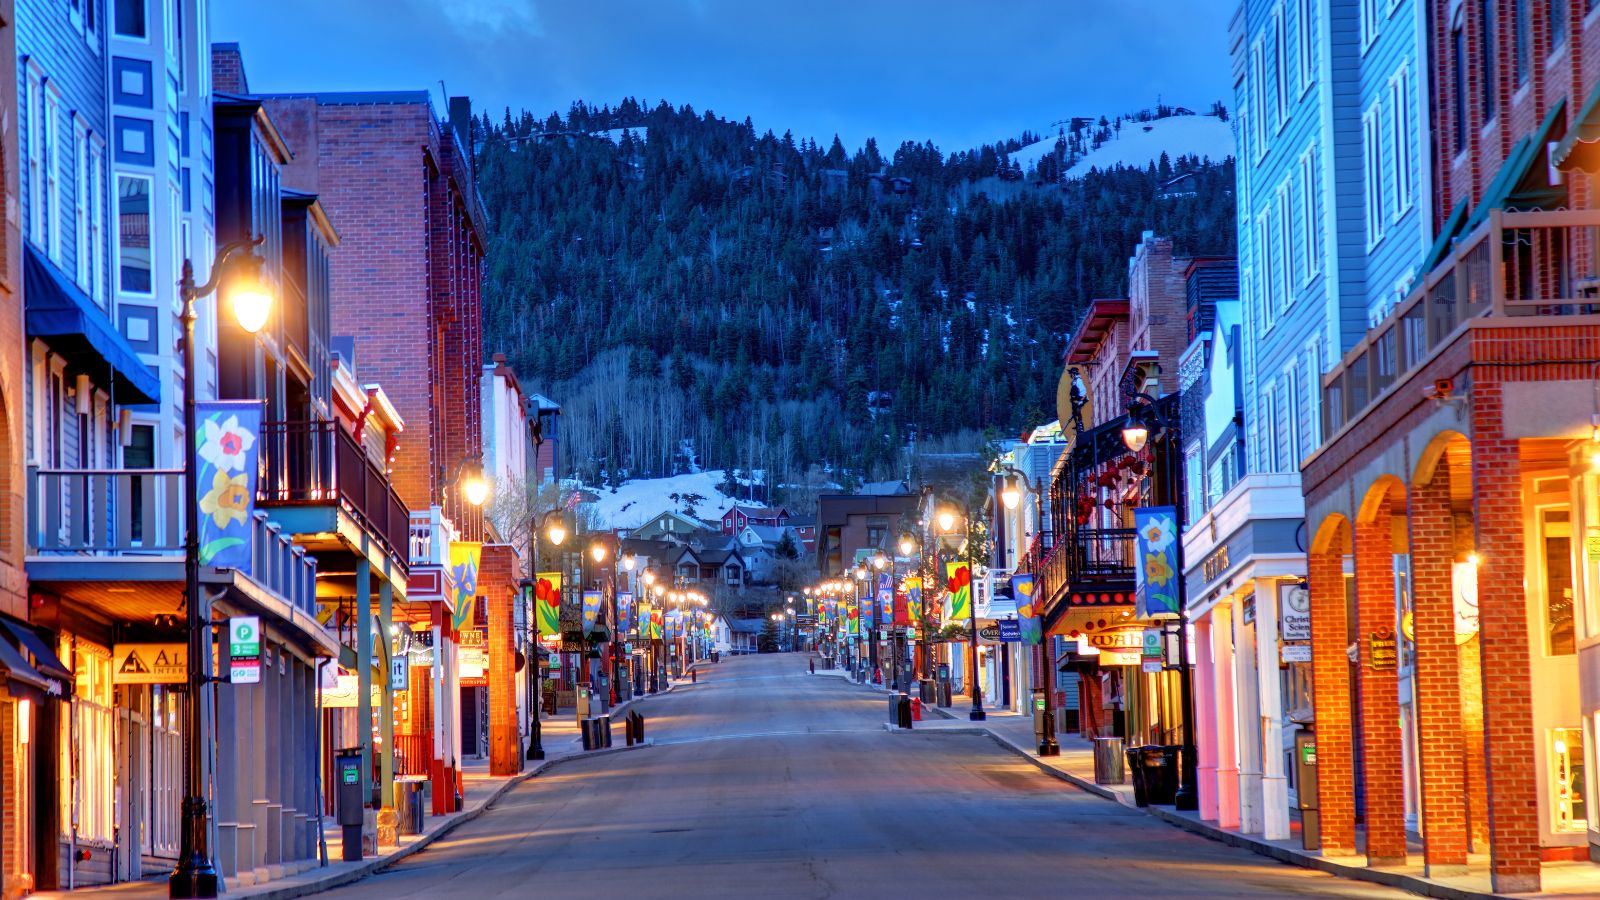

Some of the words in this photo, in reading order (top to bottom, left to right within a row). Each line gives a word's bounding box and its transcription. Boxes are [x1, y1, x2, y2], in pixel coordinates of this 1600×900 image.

[241, 627, 249, 639] P
[233, 644, 241, 655] 3
[153, 666, 185, 675] INTER
[394, 661, 403, 676] it
